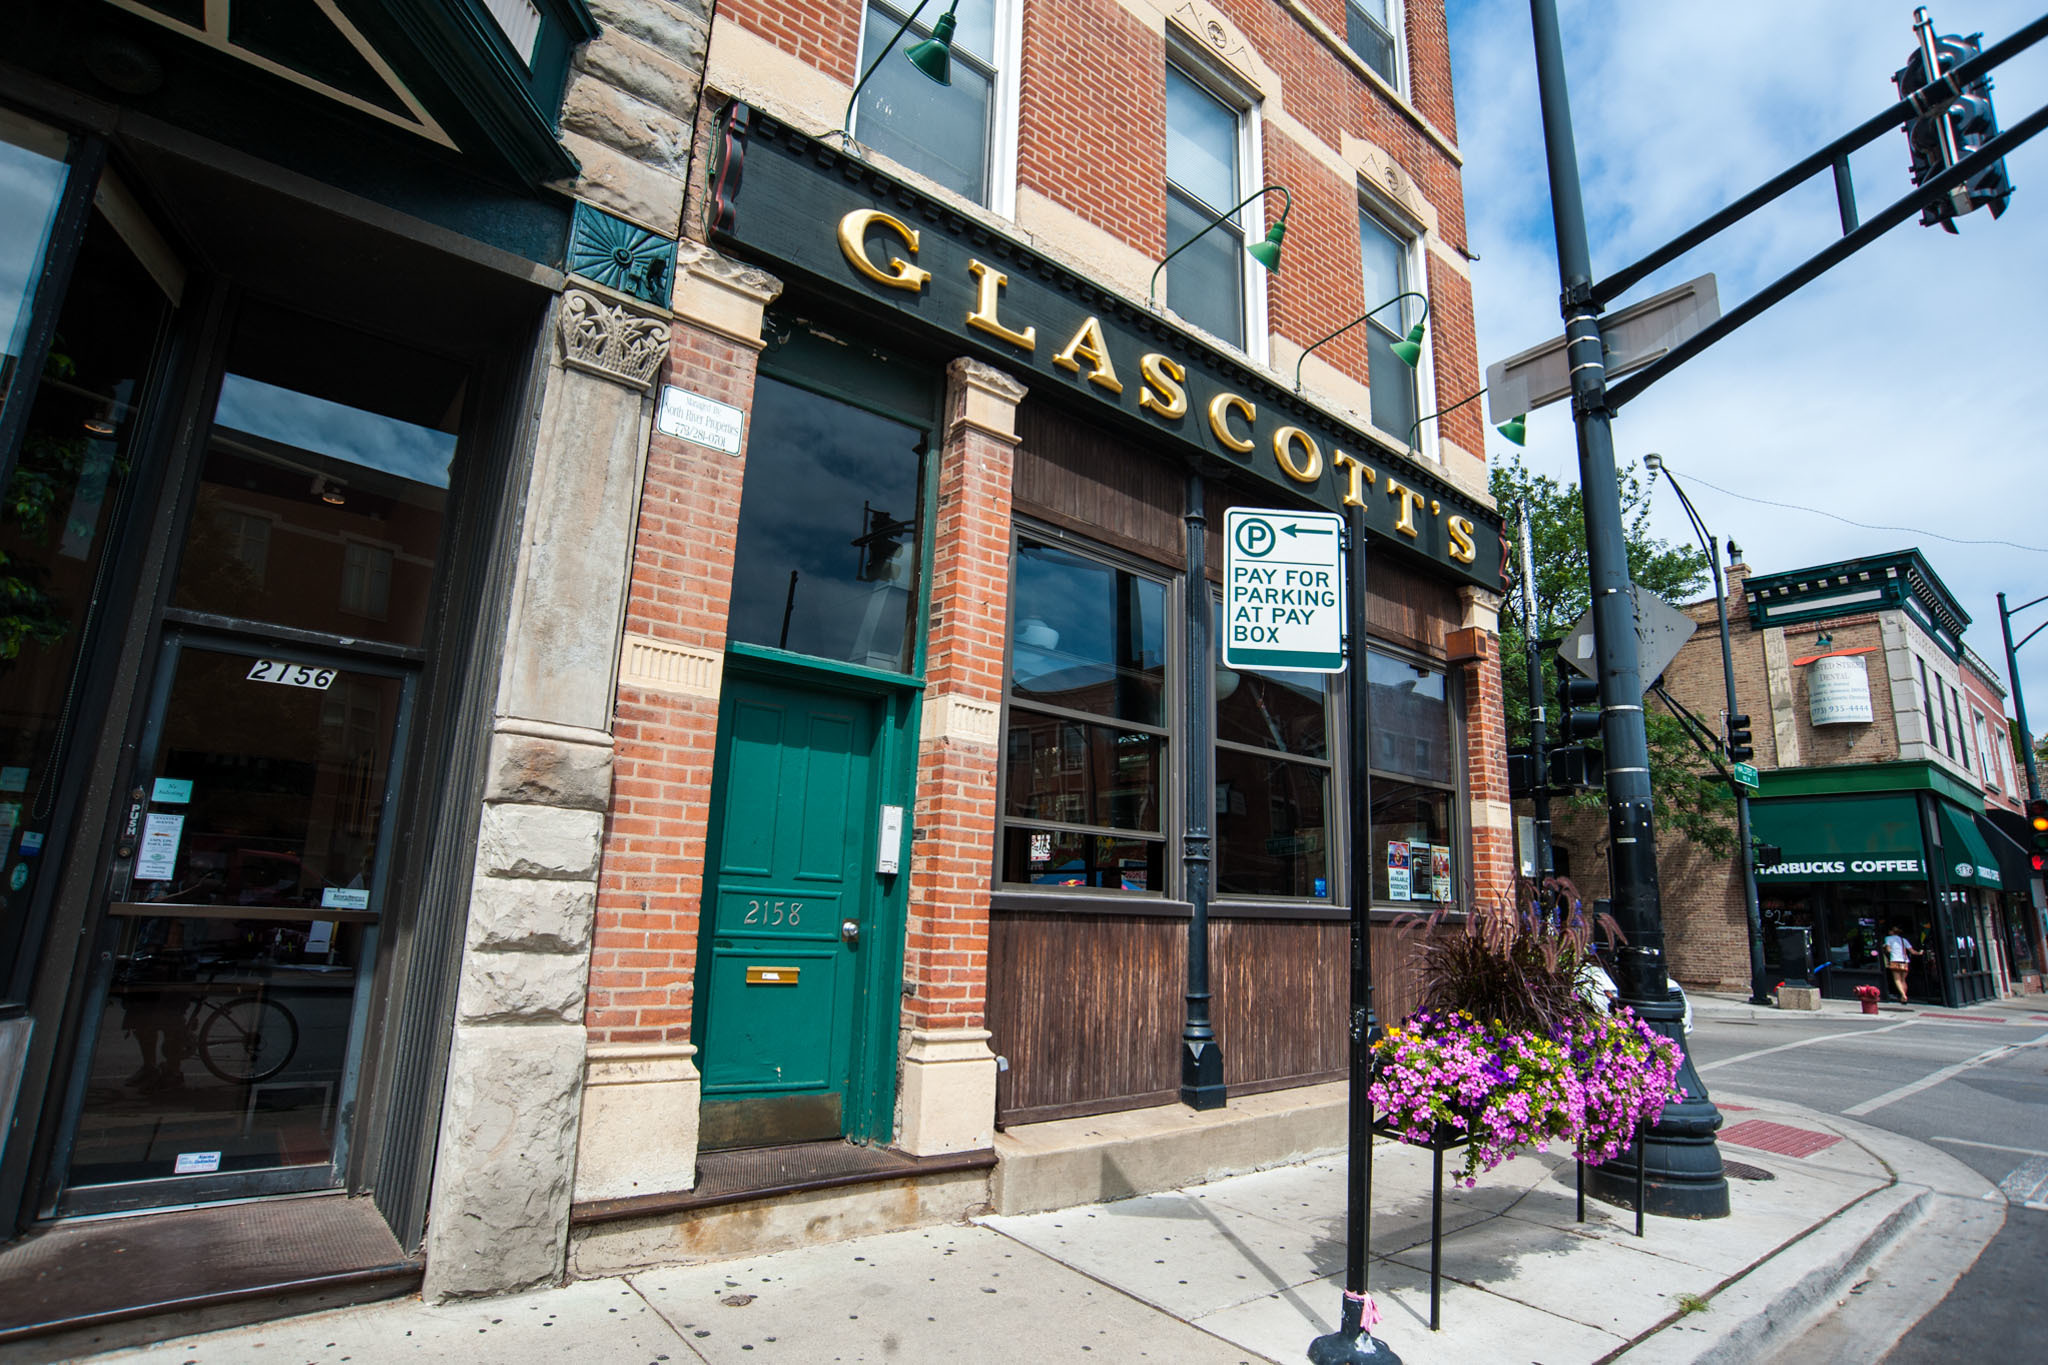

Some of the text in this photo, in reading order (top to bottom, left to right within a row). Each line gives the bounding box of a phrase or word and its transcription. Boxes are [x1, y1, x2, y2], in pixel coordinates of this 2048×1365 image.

[837, 208, 1476, 564] GLASCOTT'S
[665, 402, 739, 436] North River Properties
[1235, 567, 1329, 587] PAY FOR
[1235, 586, 1335, 607] PARKING
[1235, 606, 1315, 625] AT PAY
[1235, 625, 1280, 643] BOX
[250, 660, 334, 688] 2156
[1819, 671, 1850, 681] DENTAL
[1828, 704, 1869, 713] 935-4444
[127, 803, 141, 836] PUSH
[1755, 859, 1919, 875] TARBUCKS COFFEE
[744, 900, 804, 927] 2158
